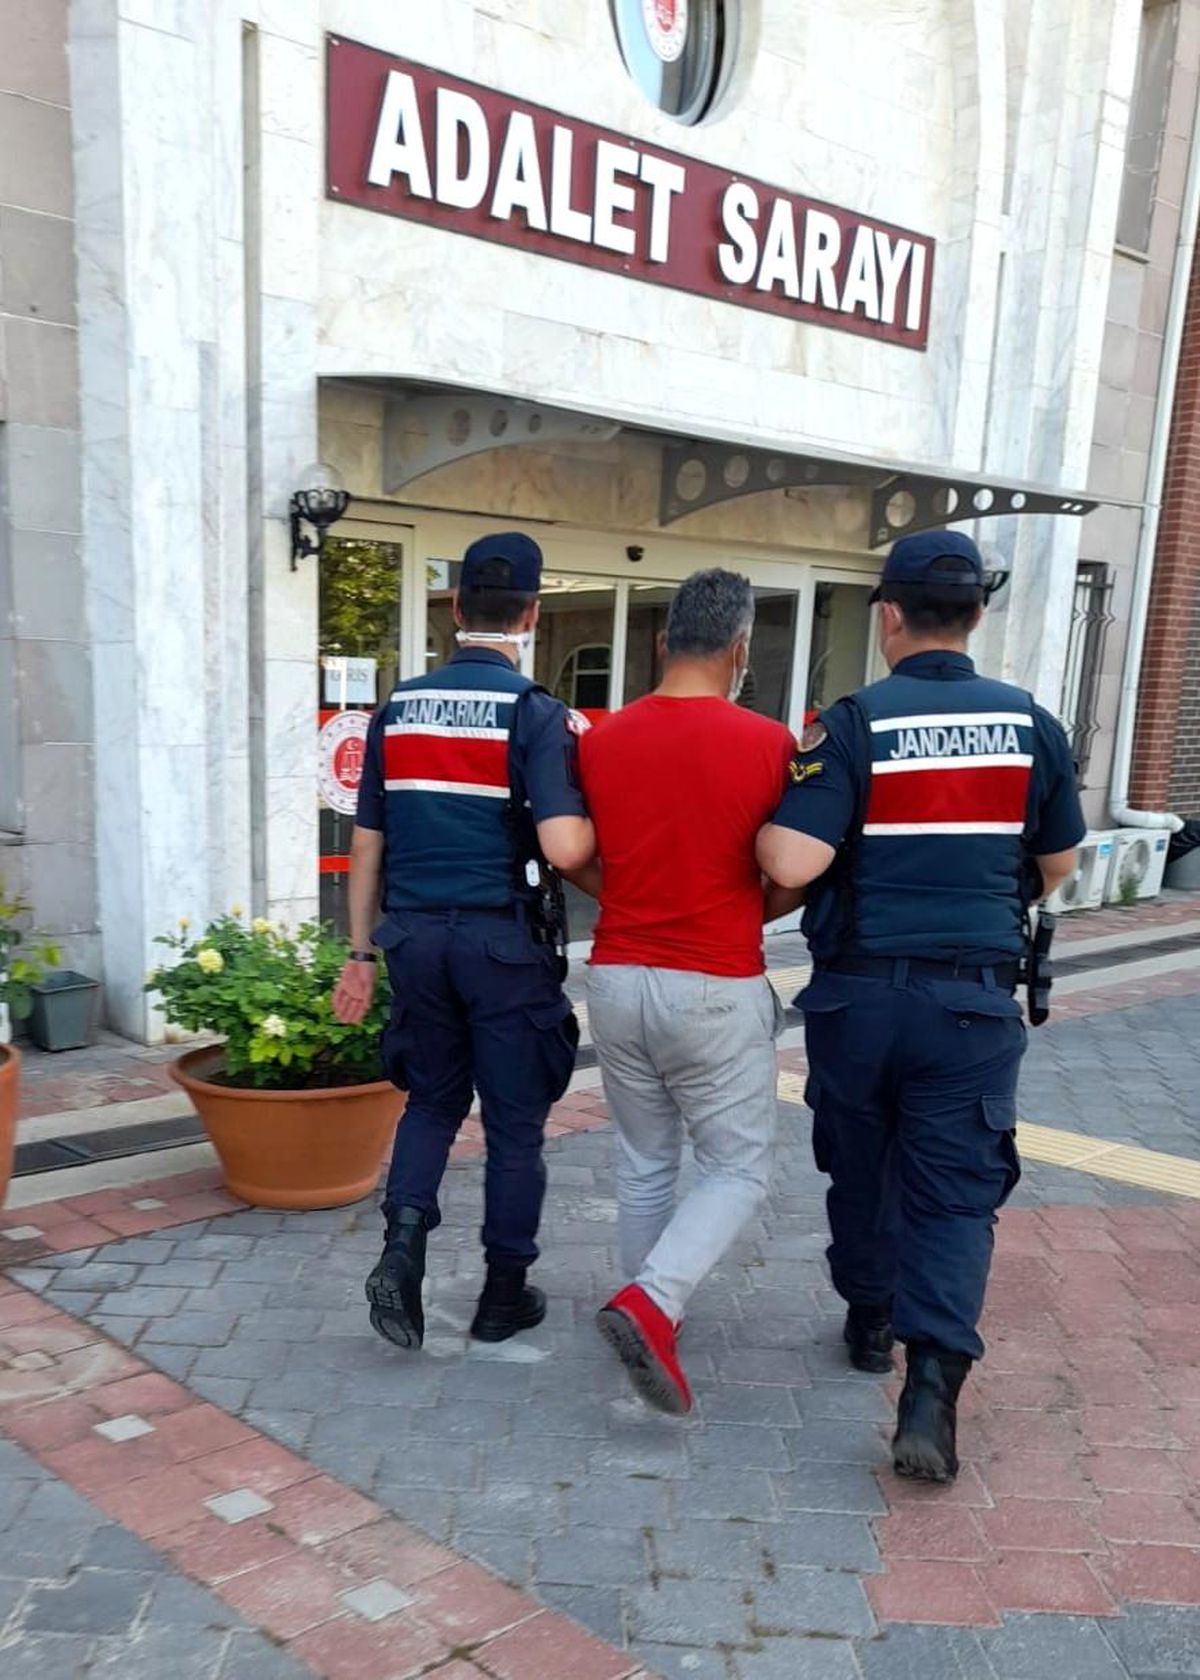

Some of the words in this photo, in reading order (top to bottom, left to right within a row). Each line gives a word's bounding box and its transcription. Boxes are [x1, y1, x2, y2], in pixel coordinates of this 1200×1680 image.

[368, 70, 686, 263] ADALET
[718, 183, 927, 331] SARAYI
[396, 699, 497, 727] JANDARMA
[890, 725, 1020, 759] JANDARMA
